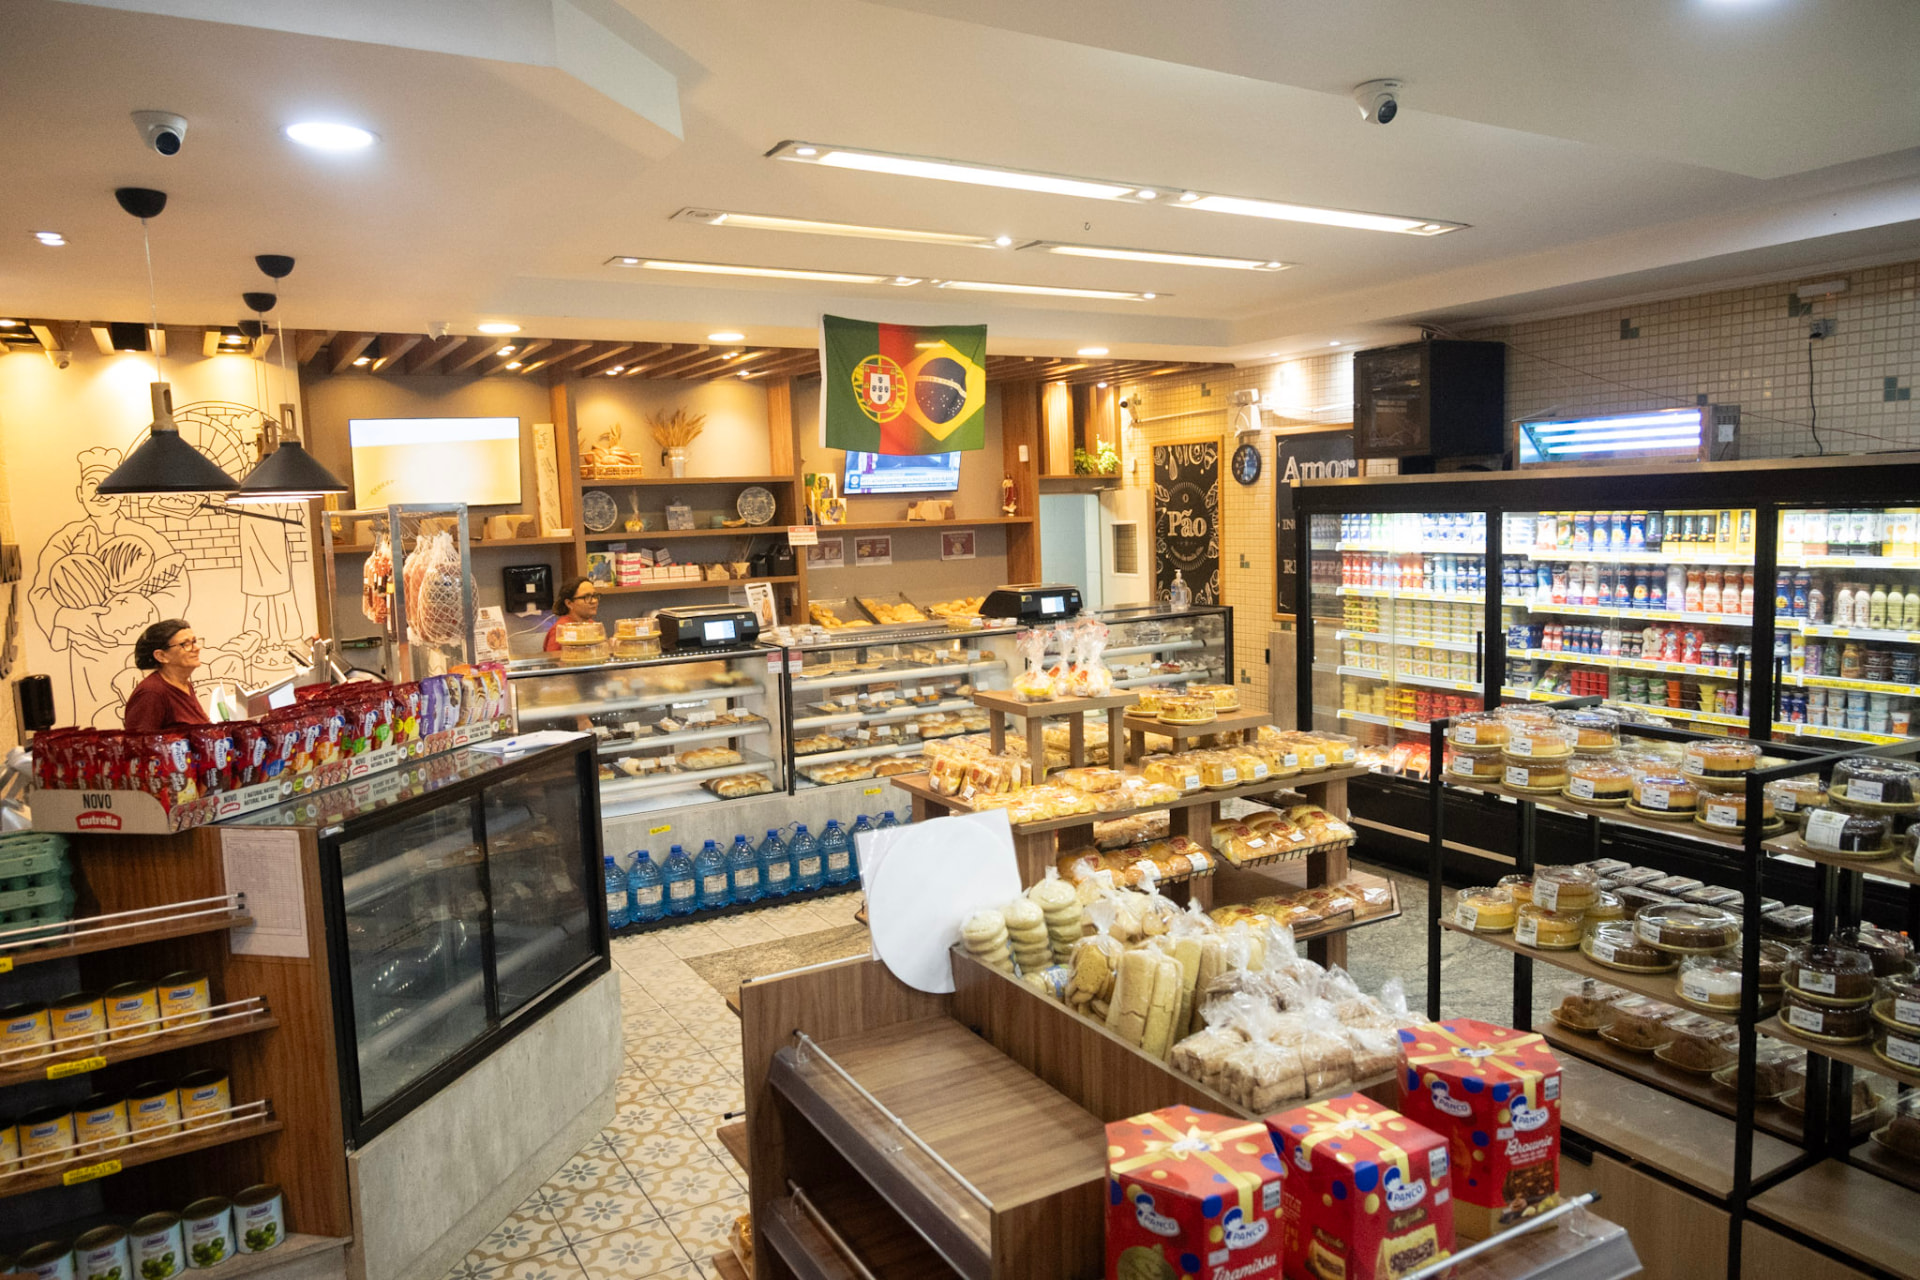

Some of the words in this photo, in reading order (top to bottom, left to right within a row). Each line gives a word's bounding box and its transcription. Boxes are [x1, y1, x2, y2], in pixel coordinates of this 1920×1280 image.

[1281, 456, 1356, 483] Amor
[1167, 509, 1207, 537] Pão
[175, 746, 186, 769] PANCO
[82, 793, 112, 809] NOVO
[80, 814, 119, 827] nutrella
[1439, 1098, 1468, 1112] PANCO
[1518, 1111, 1546, 1125] PANCO
[1505, 1135, 1553, 1155] Brownie
[1393, 1184, 1422, 1202] PANCO
[1144, 1214, 1176, 1231] PANCO
[1233, 1223, 1265, 1241] PANCO
